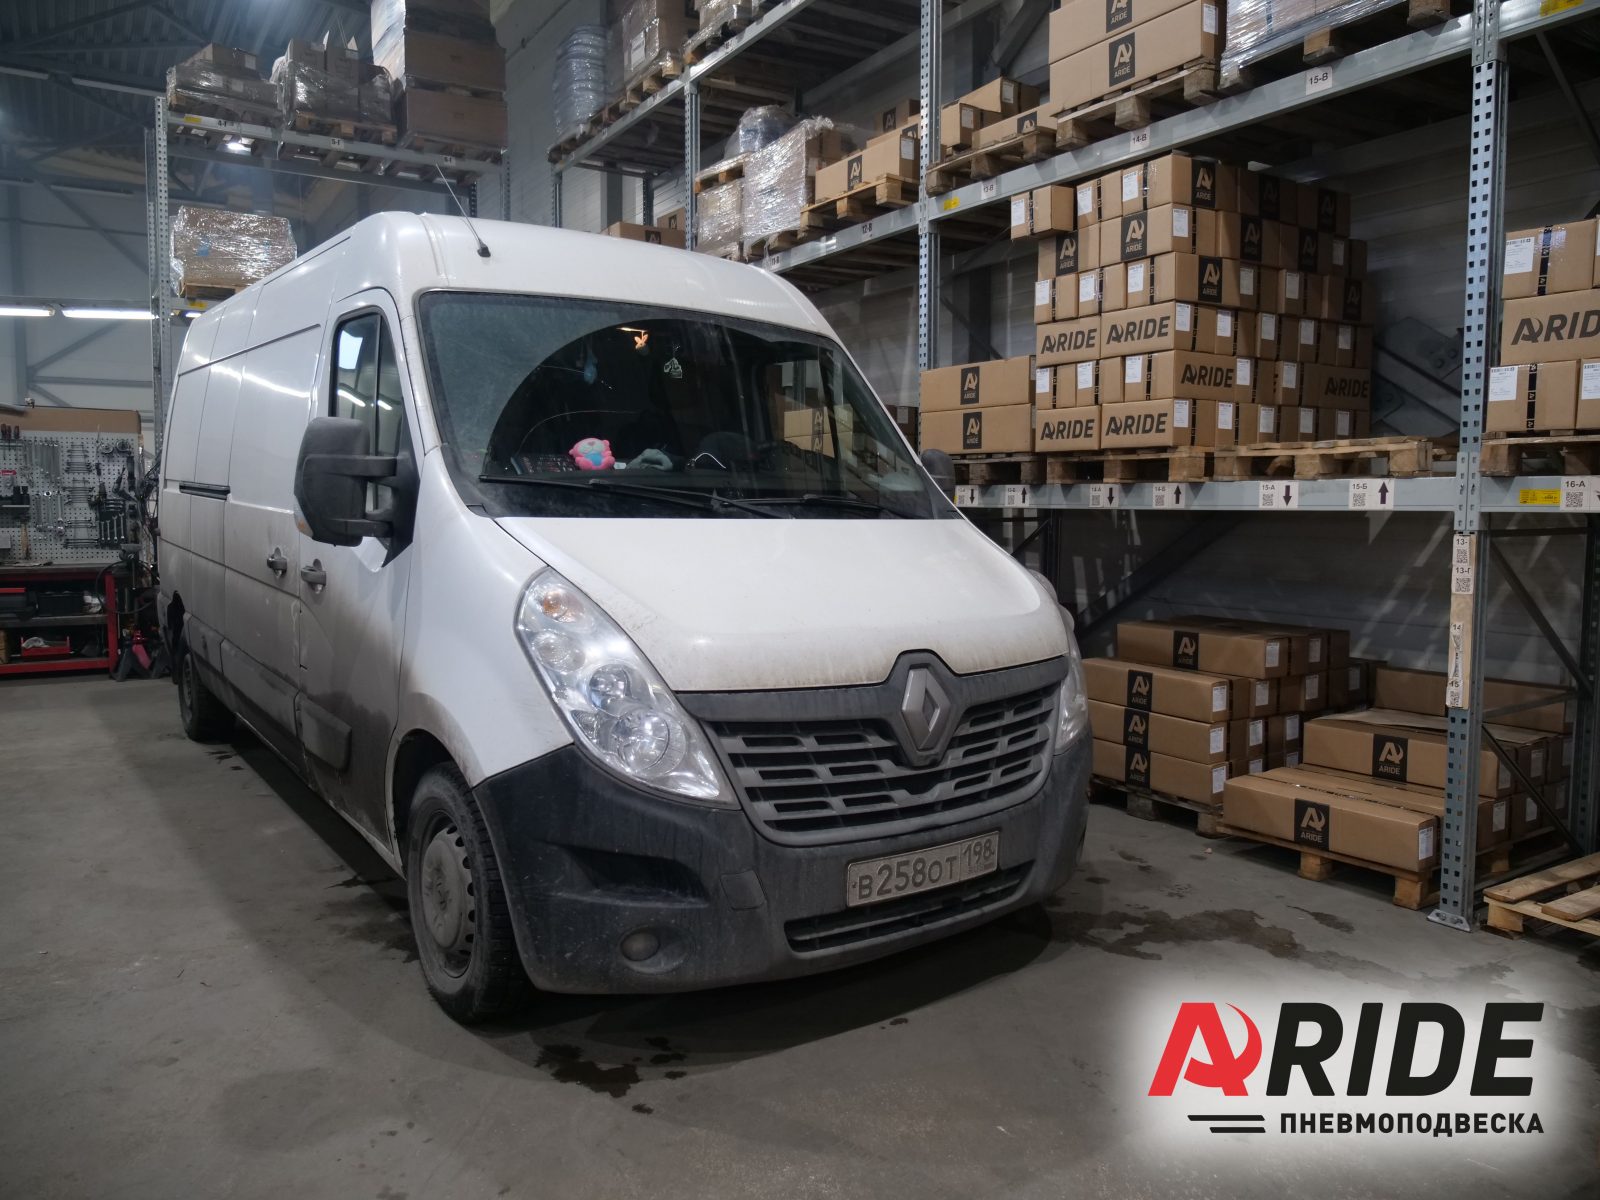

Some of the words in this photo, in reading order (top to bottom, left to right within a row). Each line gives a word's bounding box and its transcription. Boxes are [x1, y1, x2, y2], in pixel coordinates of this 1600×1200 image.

[1111, 11, 1128, 24] ARIDE
[1114, 66, 1130, 78] ARIDE
[1126, 242, 1142, 254] ARIDE
[1060, 260, 1074, 270] ARIDE
[1106, 316, 1170, 344] ARIDE
[1040, 328, 1098, 354] ARIDE
[1180, 364, 1234, 388] ARIDE
[1040, 419, 1095, 440] ARIDE
[1106, 413, 1168, 436] ARIDE
[1379, 764, 1400, 775] ARIDE
[1300, 832, 1322, 843] ARIDE
